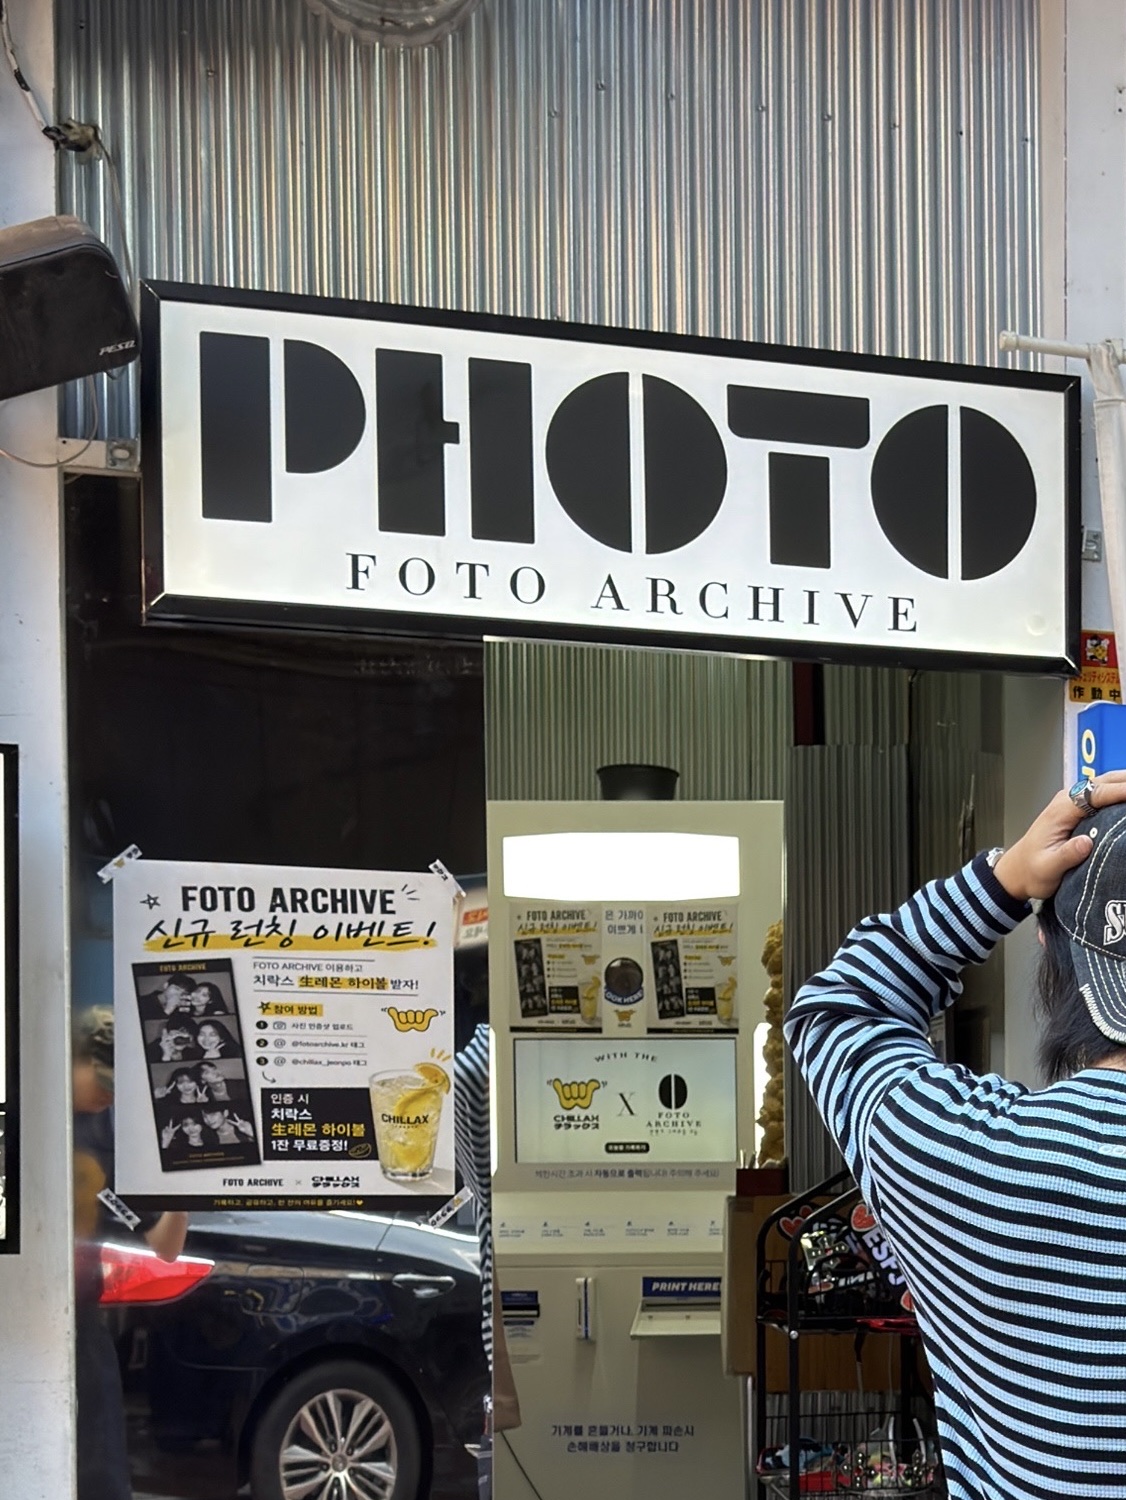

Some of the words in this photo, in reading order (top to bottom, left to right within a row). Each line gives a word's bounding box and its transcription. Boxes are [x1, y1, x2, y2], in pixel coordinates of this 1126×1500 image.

[199, 332, 1038, 582] PHOTO
[346, 552, 547, 604] FOTO
[591, 570, 918, 634] ARCHIVE
[1073, 686, 1121, 700] 作動中
[182, 886, 255, 913] FOTO
[269, 888, 396, 915] ARCHIVE
[527, 911, 548, 921] FOTO
[551, 910, 586, 920] ARCHIVE
[664, 912, 684, 922] FOTO
[687, 911, 722, 921] ARCHIVE
[145, 917, 216, 950] 신규
[230, 917, 297, 949] 런칭
[313, 920, 436, 948] 이벤트!
[253, 962, 279, 971] FOTO
[282, 963, 322, 972] ARCHIVE
[326, 963, 362, 973] 이용하고
[253, 974, 294, 987] 치락스
[299, 975, 342, 988] 生레몬
[349, 977, 388, 990] 하이볼
[390, 978, 419, 990] 받자!
[594, 1051, 628, 1062] WITH
[634, 1052, 658, 1062] THE
[271, 1093, 293, 1105] 인증
[297, 1093, 309, 1105] 시
[271, 1108, 312, 1121] 치락스
[381, 1113, 429, 1125] CHILLAX
[271, 1123, 316, 1137] 生레몬
[323, 1123, 365, 1137] 하이볼
[646, 1120, 702, 1128] ARCHIVE
[271, 1139, 289, 1151] 1잔
[293, 1139, 349, 1152] 무료증정!
[223, 1178, 244, 1187] FOTO
[247, 1178, 283, 1187] ARCHIVE
[651, 1281, 688, 1291] PRINT
[552, 1425, 583, 1436] 기계를
[638, 1425, 658, 1436] 기계
